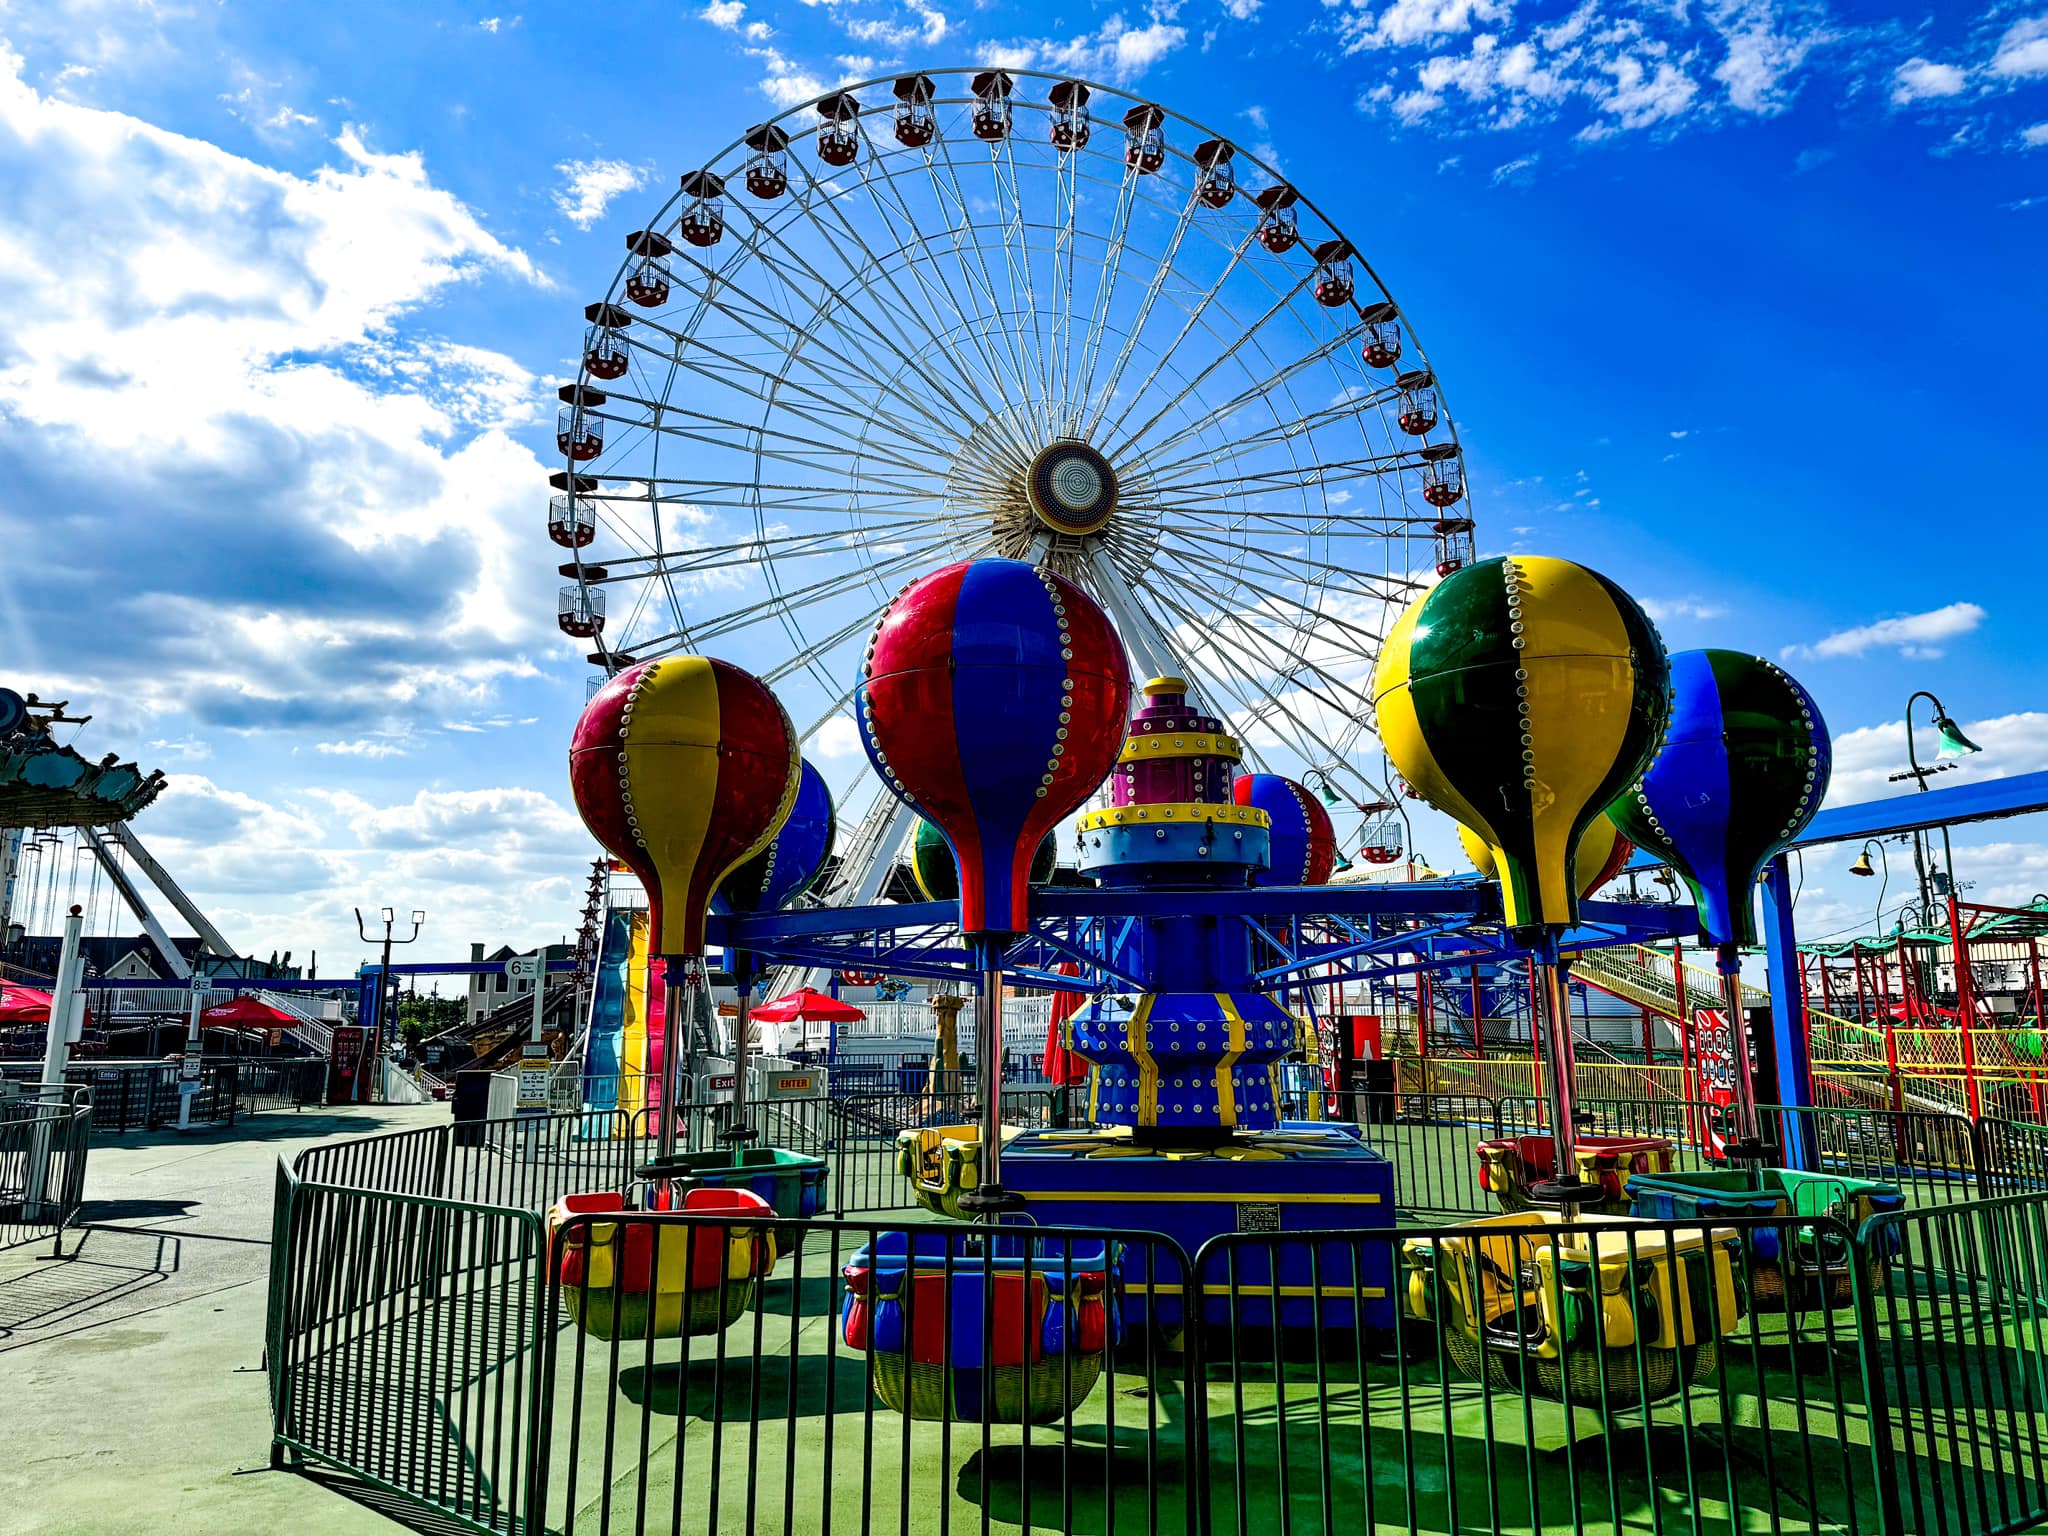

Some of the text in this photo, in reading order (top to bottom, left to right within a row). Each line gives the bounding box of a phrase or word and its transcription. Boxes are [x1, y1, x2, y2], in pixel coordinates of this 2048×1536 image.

[511, 961, 521, 975] 6
[194, 980, 201, 990] 8
[715, 1078, 736, 1088] Exit
[781, 1079, 807, 1088] ENTER
[1543, 1264, 1552, 1281] 3
